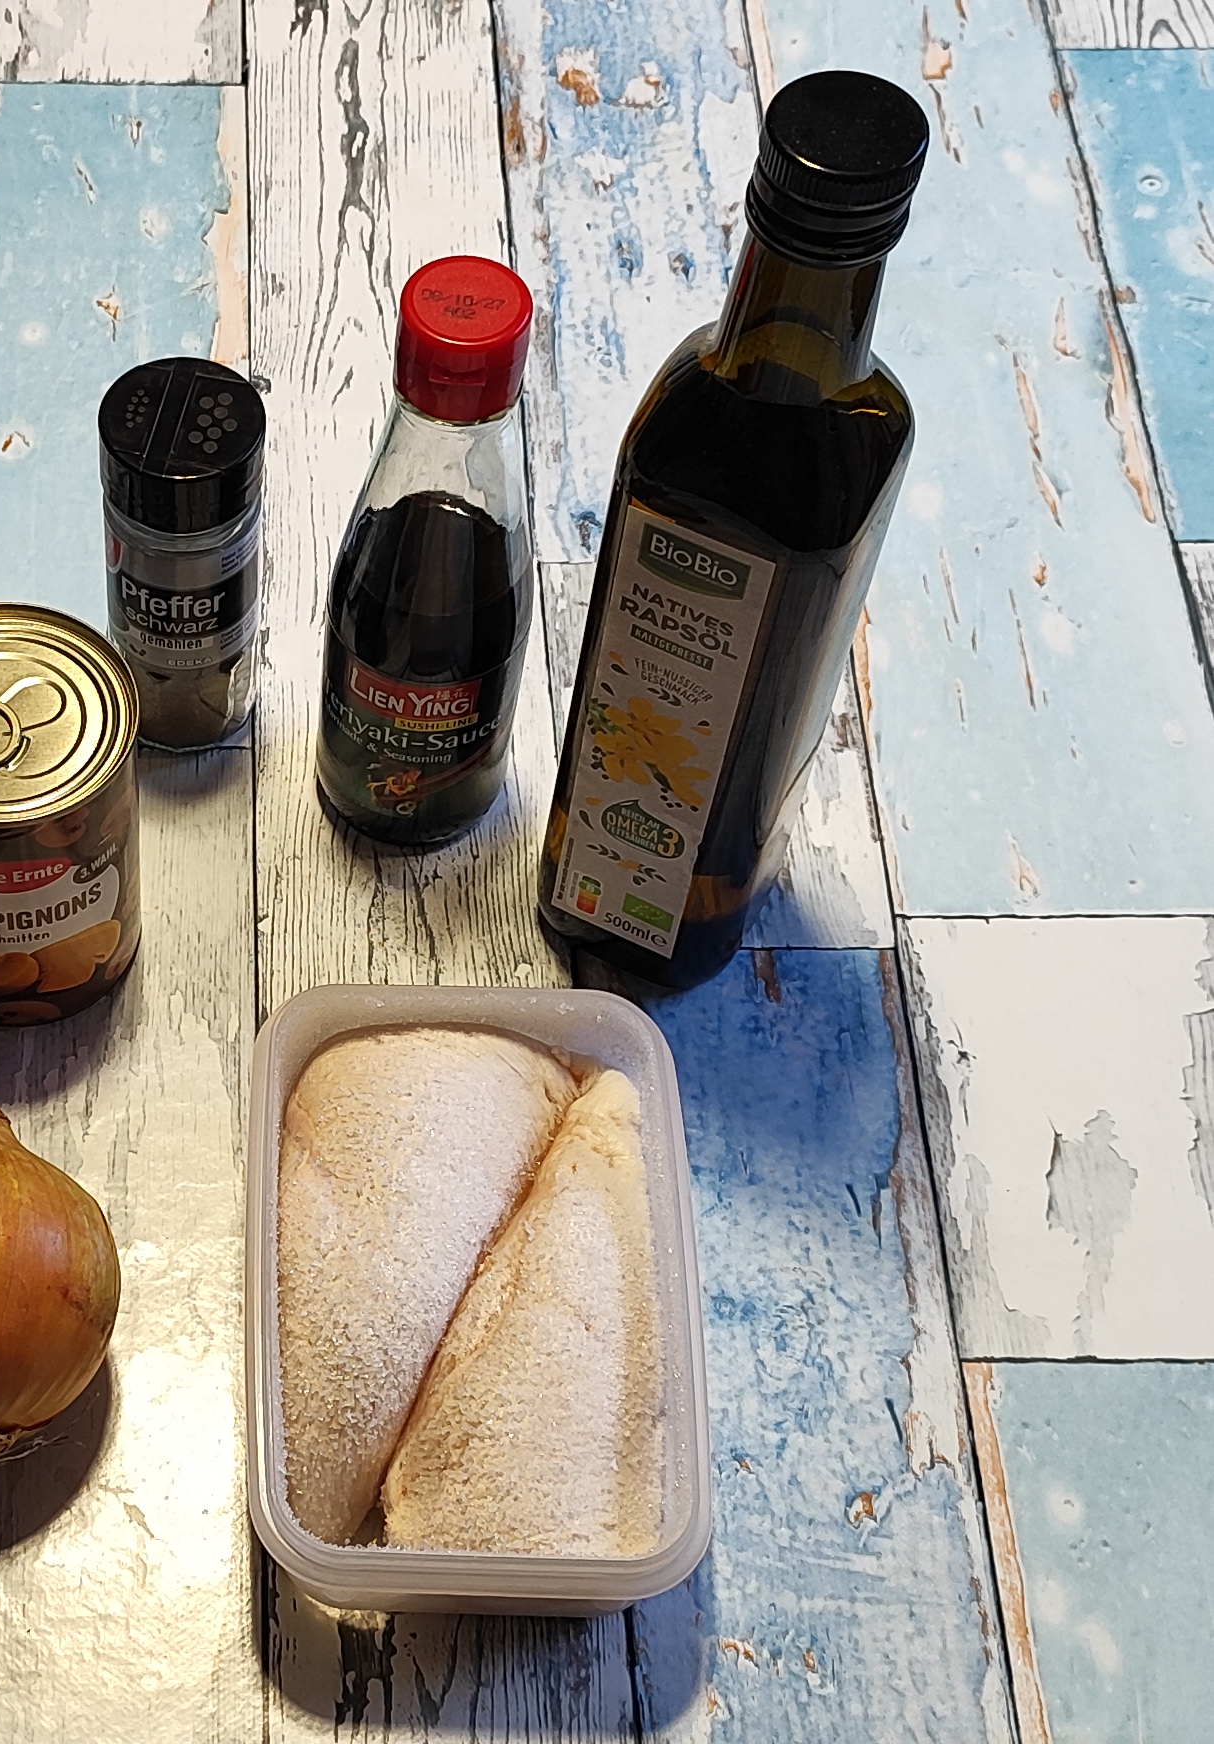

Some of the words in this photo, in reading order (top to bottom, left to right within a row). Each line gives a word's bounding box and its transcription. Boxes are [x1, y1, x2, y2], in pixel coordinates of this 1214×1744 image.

[650, 533, 738, 586] BioBio
[121, 575, 226, 619] Pfeffer
[632, 583, 735, 637] NATIVES
[126, 606, 219, 634] schwarz
[619, 596, 739, 661] RAPSÖL
[140, 632, 203, 650] gemahlen
[634, 628, 710, 669] KALTGEPRESST
[167, 657, 214, 667] EDEKA
[350, 667, 406, 714] LIEN
[407, 692, 470, 717] YING
[641, 671, 703, 706] GESCHMACK
[399, 719, 441, 730] SUSHI
[445, 716, 475, 728] LINE
[366, 742, 379, 753] &
[383, 749, 453, 764] Seasoning
[621, 807, 646, 824] REICH
[647, 820, 661, 830] AN
[606, 811, 658, 843] OMEGA
[657, 828, 679, 857] 3
[12, 863, 65, 883] Ernte
[91, 845, 118, 873] WAHL
[603, 912, 651, 941] 500ml
